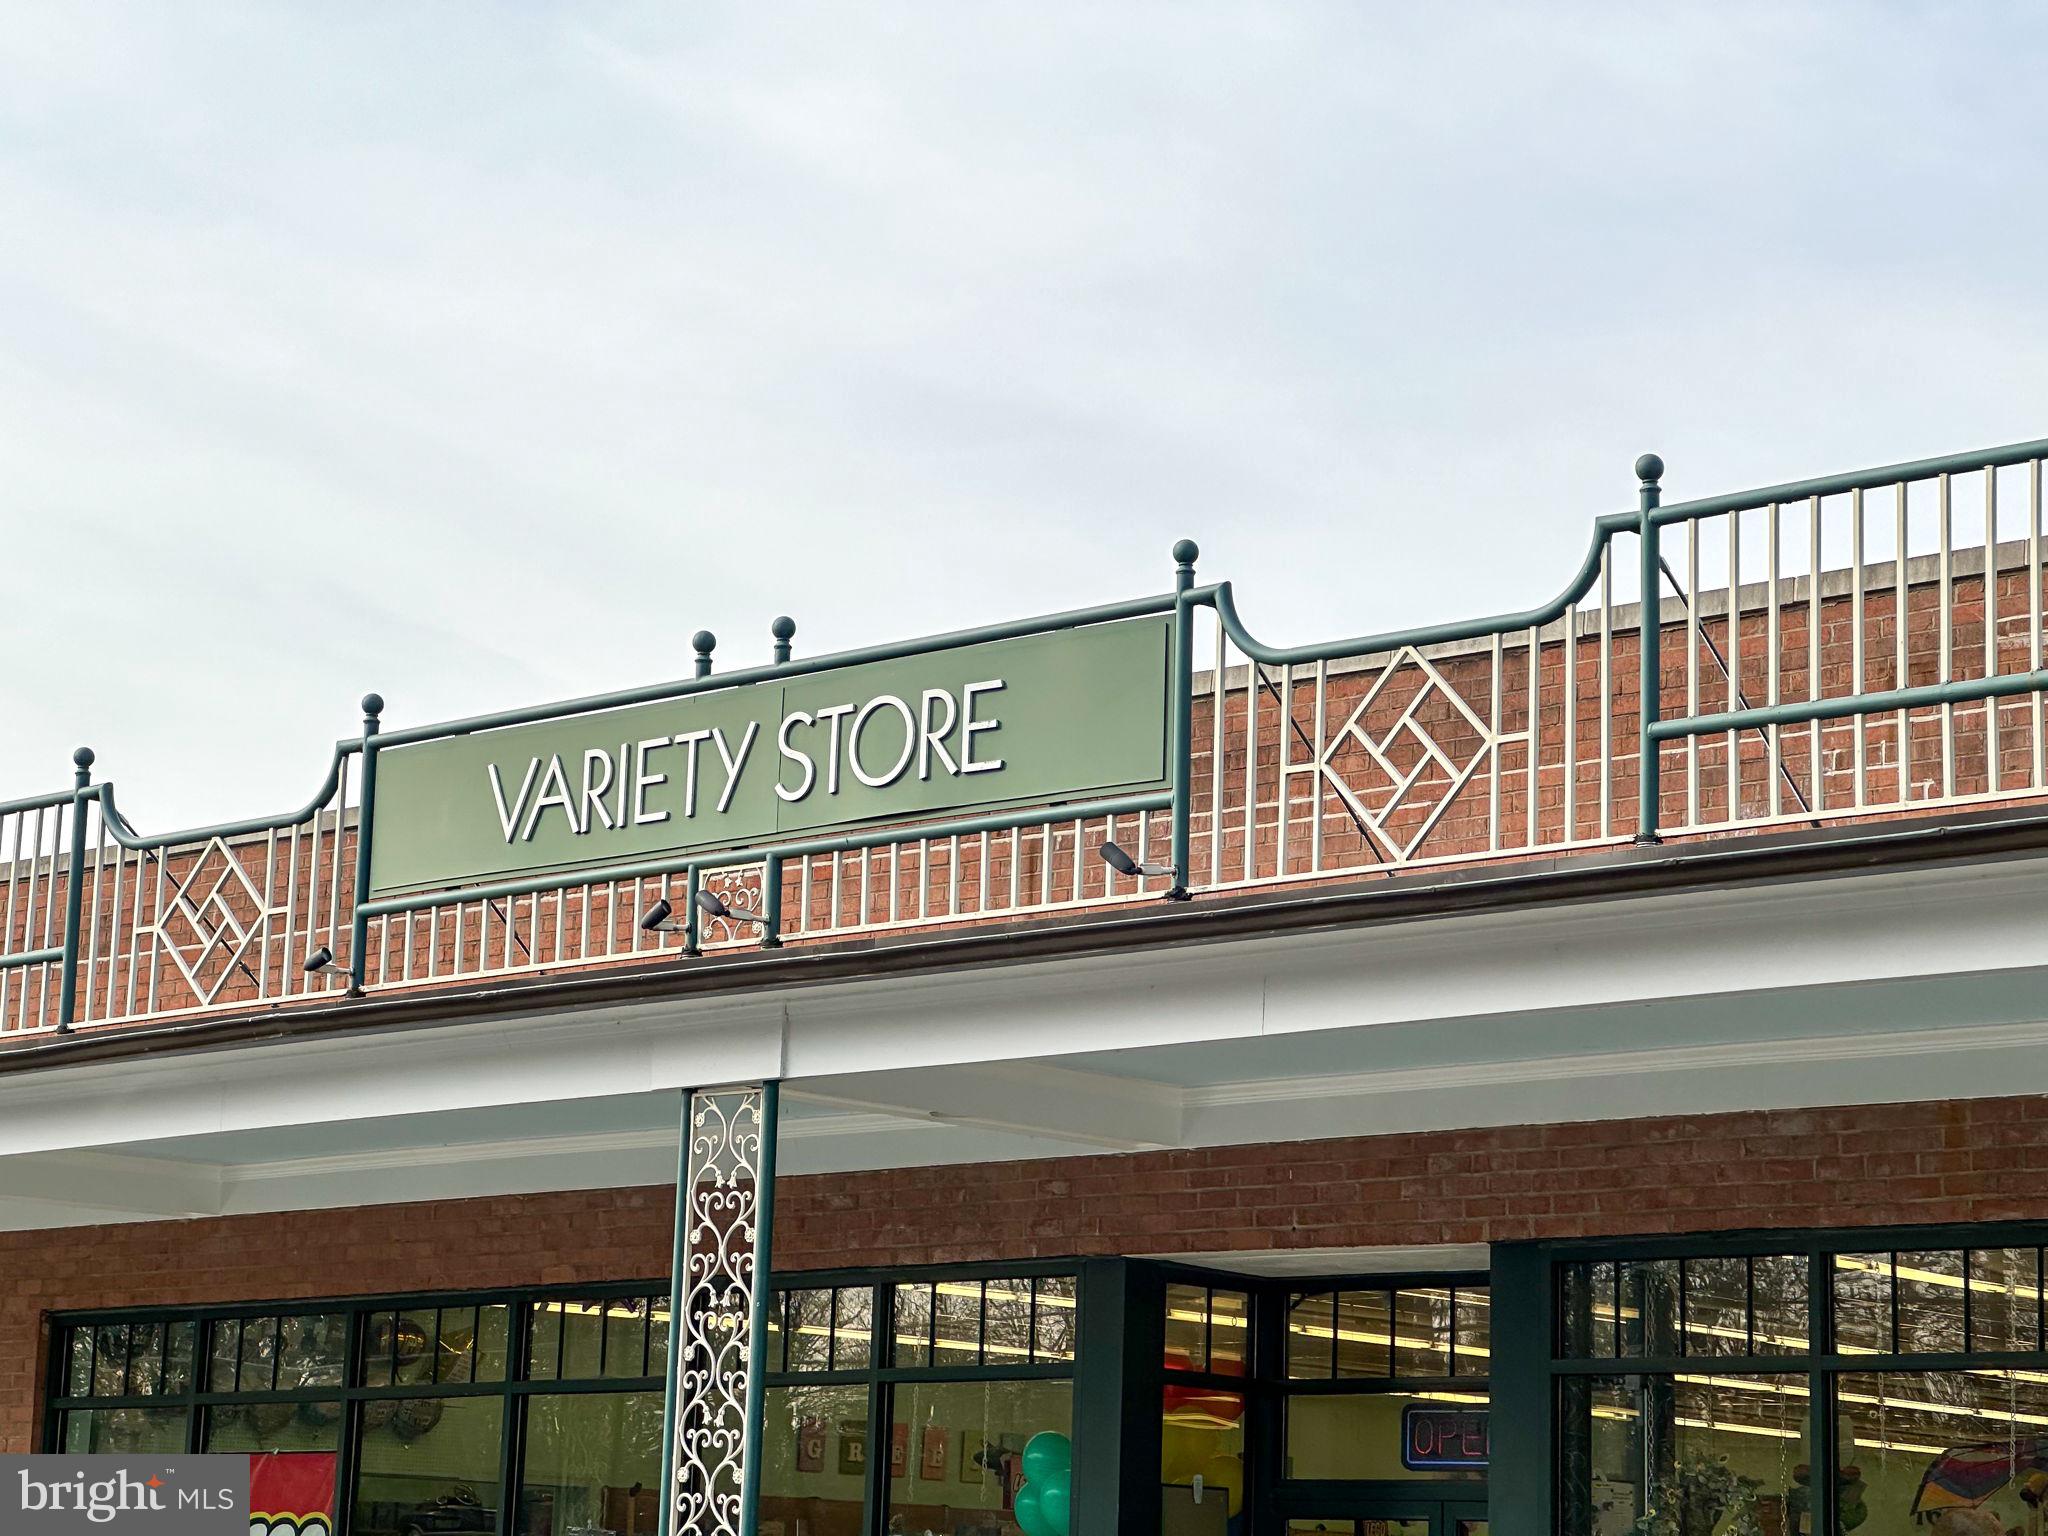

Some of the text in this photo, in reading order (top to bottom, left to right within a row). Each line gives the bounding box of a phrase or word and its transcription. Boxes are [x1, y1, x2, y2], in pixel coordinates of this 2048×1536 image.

[487, 679, 1007, 844] VARIETY STORE
[1414, 1420, 1490, 1456] OPE
